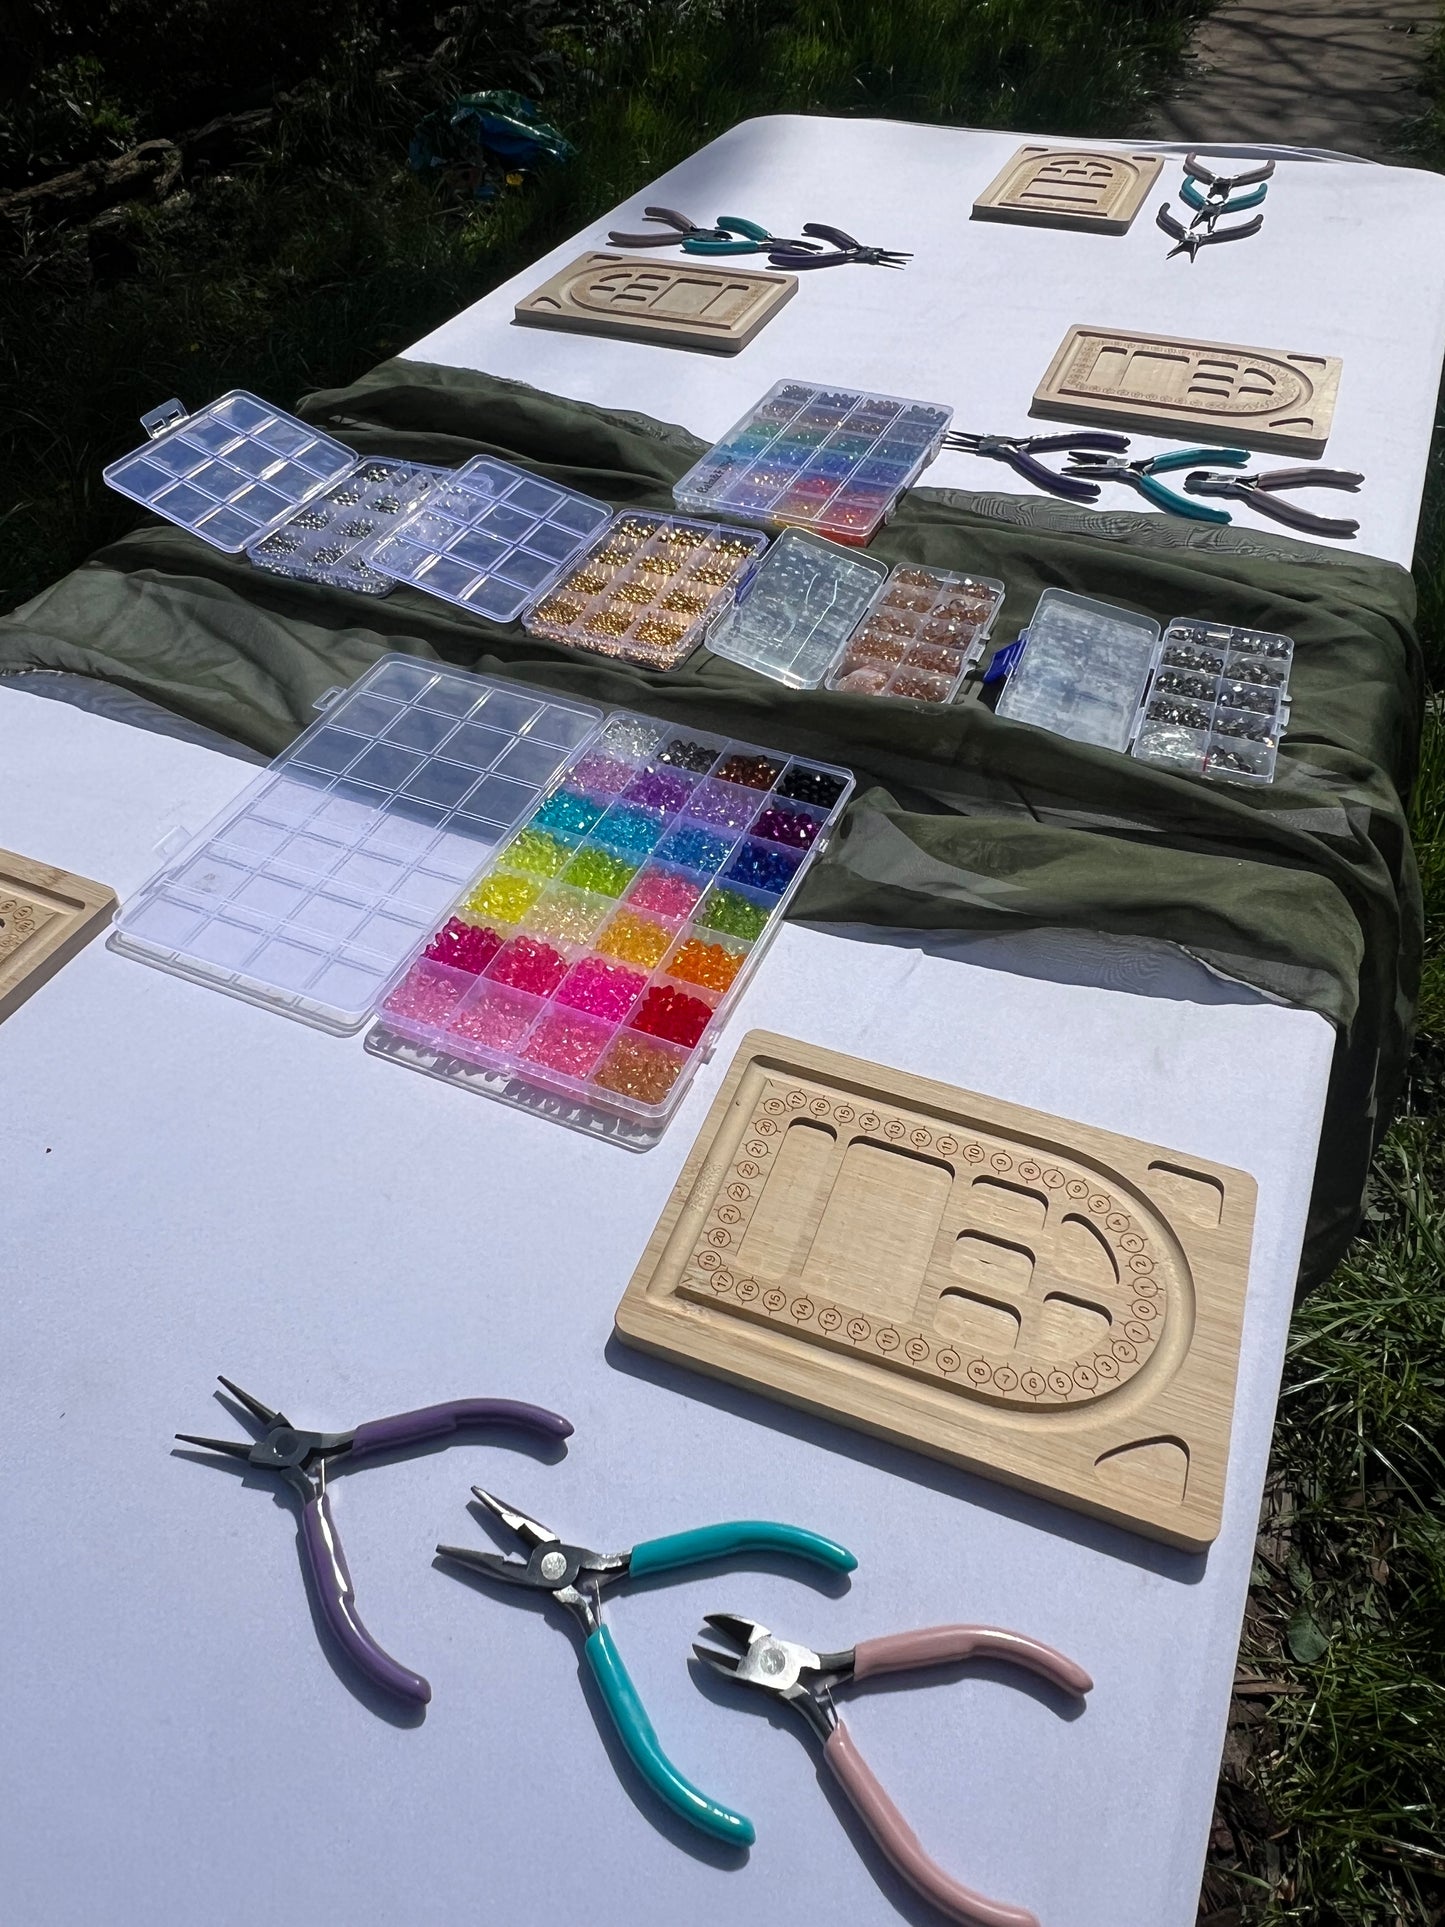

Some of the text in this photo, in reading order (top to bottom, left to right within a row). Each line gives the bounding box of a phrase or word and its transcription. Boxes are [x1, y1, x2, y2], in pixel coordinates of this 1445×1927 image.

[791, 1094, 802, 1105] 17
[769, 1101, 780, 1111] 19
[814, 1102, 826, 1112] 16
[838, 1109, 850, 1119] 15
[760, 1121, 772, 1133] 20
[864, 1117, 875, 1127] 14
[889, 1124, 901, 1135] 13
[915, 1132, 927, 1142] 12
[751, 1142, 763, 1154] 21
[941, 1141, 953, 1150] 11
[968, 1148, 980, 1158] 10
[996, 1157, 1007, 1167] 9
[742, 1163, 755, 1176] 22
[1024, 1166, 1035, 1176] 8
[1049, 1174, 1058, 1183] 7
[732, 1185, 745, 1199] 22
[1072, 1184, 1082, 1194] 6
[1094, 1199, 1105, 1209] 5
[723, 1208, 736, 1221] 21
[1112, 1218, 1122, 1227] 4
[713, 1230, 726, 1245] 20
[1126, 1238, 1138, 1248] 3
[703, 1254, 716, 1267] 19
[1135, 1259, 1147, 1269] 2
[717, 1274, 729, 1287] 17
[741, 1284, 754, 1296] 16
[768, 1294, 781, 1306] 15
[796, 1303, 809, 1316] 14
[1138, 1305, 1150, 1314] 0
[823, 1313, 837, 1325] 13
[852, 1322, 865, 1336] 12
[1131, 1327, 1143, 1337] 1
[882, 1333, 894, 1344] 11
[911, 1343, 924, 1356] 10
[1118, 1345, 1130, 1356] 2
[942, 1356, 954, 1365] 9
[973, 1367, 985, 1376] 8
[1101, 1361, 1112, 1372] 3
[1001, 1373, 1011, 1384] 7
[1080, 1371, 1090, 1381] 4
[1028, 1377, 1038, 1389] 6
[1055, 1377, 1065, 1388] 5
